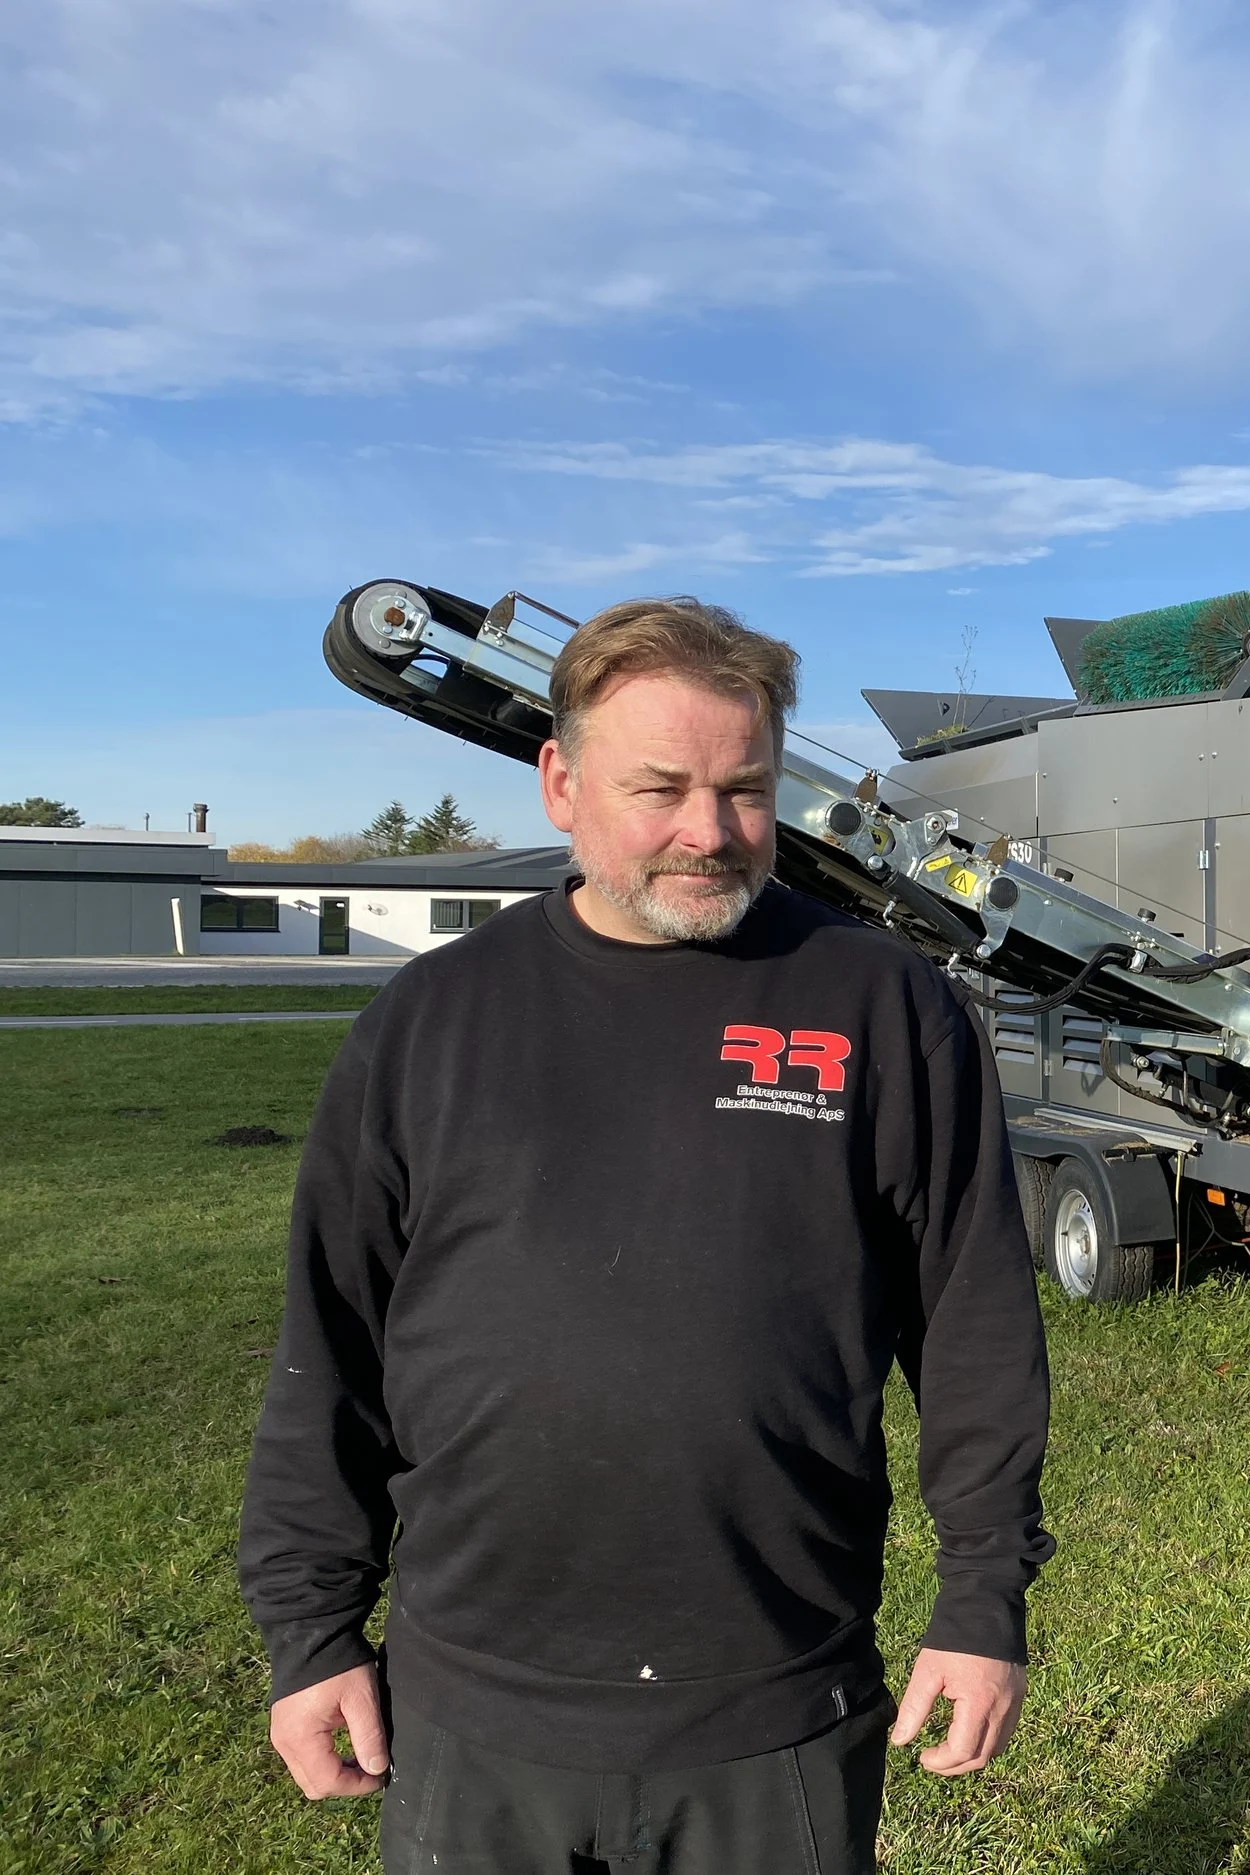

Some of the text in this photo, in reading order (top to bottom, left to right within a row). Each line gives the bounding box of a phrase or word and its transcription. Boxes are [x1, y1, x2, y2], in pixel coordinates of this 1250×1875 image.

[736, 1084, 828, 1106] Entreprenør &
[715, 1097, 846, 1122] Maskinudlejning ApS
